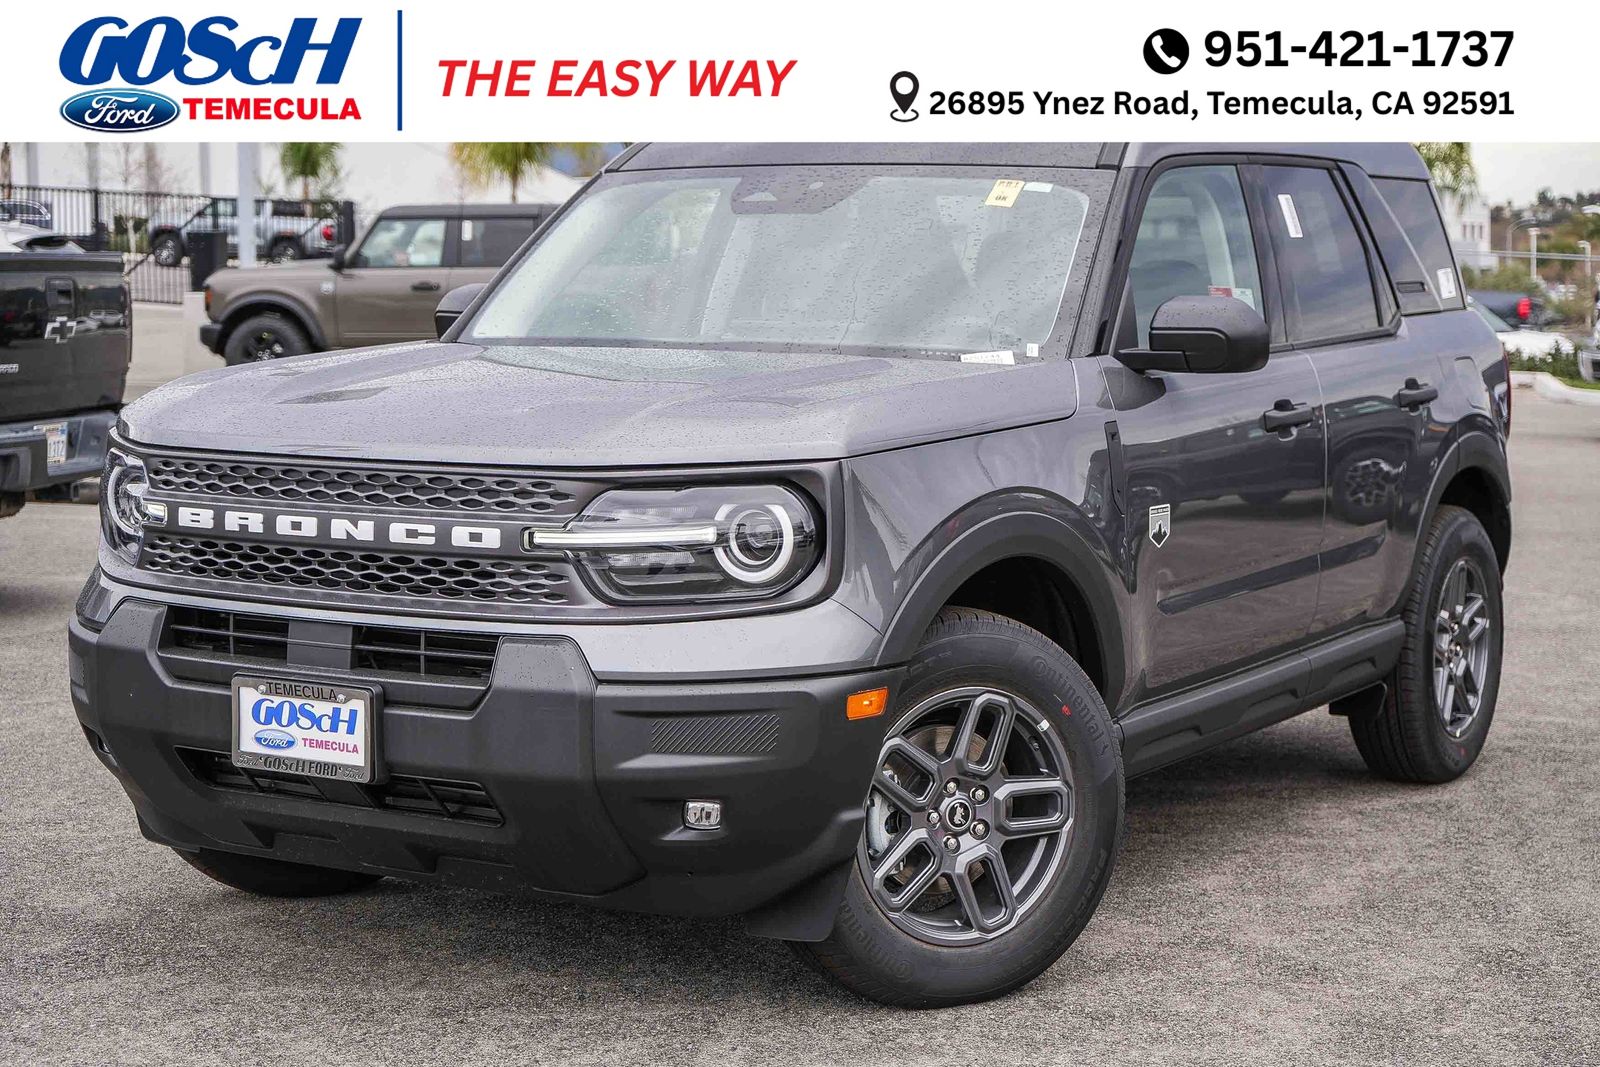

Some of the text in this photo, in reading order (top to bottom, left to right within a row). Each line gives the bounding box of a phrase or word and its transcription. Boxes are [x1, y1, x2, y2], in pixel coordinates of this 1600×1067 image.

[178, 507, 501, 549] BRONCO
[266, 682, 337, 701] TEMECULA
[261, 732, 289, 748] Ford
[302, 737, 359, 754] TEMECULA
[308, 760, 338, 777] FORD
